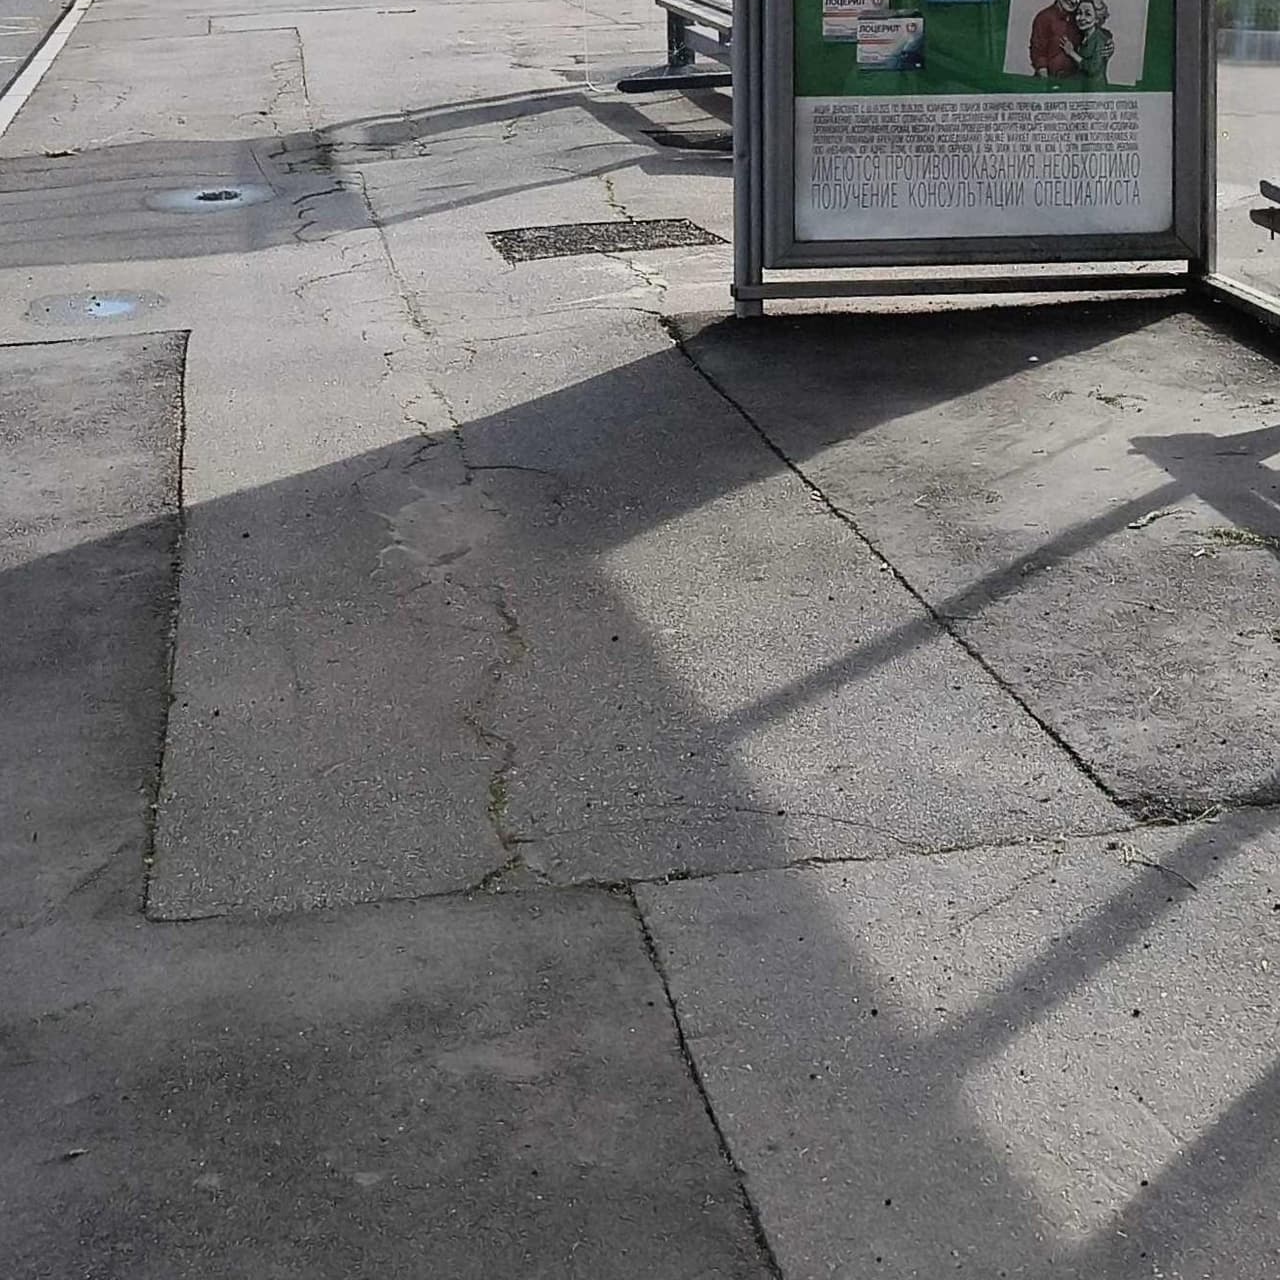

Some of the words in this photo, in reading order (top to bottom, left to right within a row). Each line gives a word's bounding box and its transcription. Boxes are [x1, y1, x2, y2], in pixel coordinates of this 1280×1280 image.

[812, 155, 881, 182] ИМЕЮТСЯ
[887, 154, 1039, 181] ПРОТИВОПОКАЗАНИЯ.
[1044, 152, 1140, 179] НЕОБХОДИМО
[812, 182, 898, 209] ПОЛУЧЕНИЕ
[908, 181, 1025, 210] КОНСУЛЬТАЦИИ
[1034, 180, 1140, 207] СПЕЦИАЛИСТА
